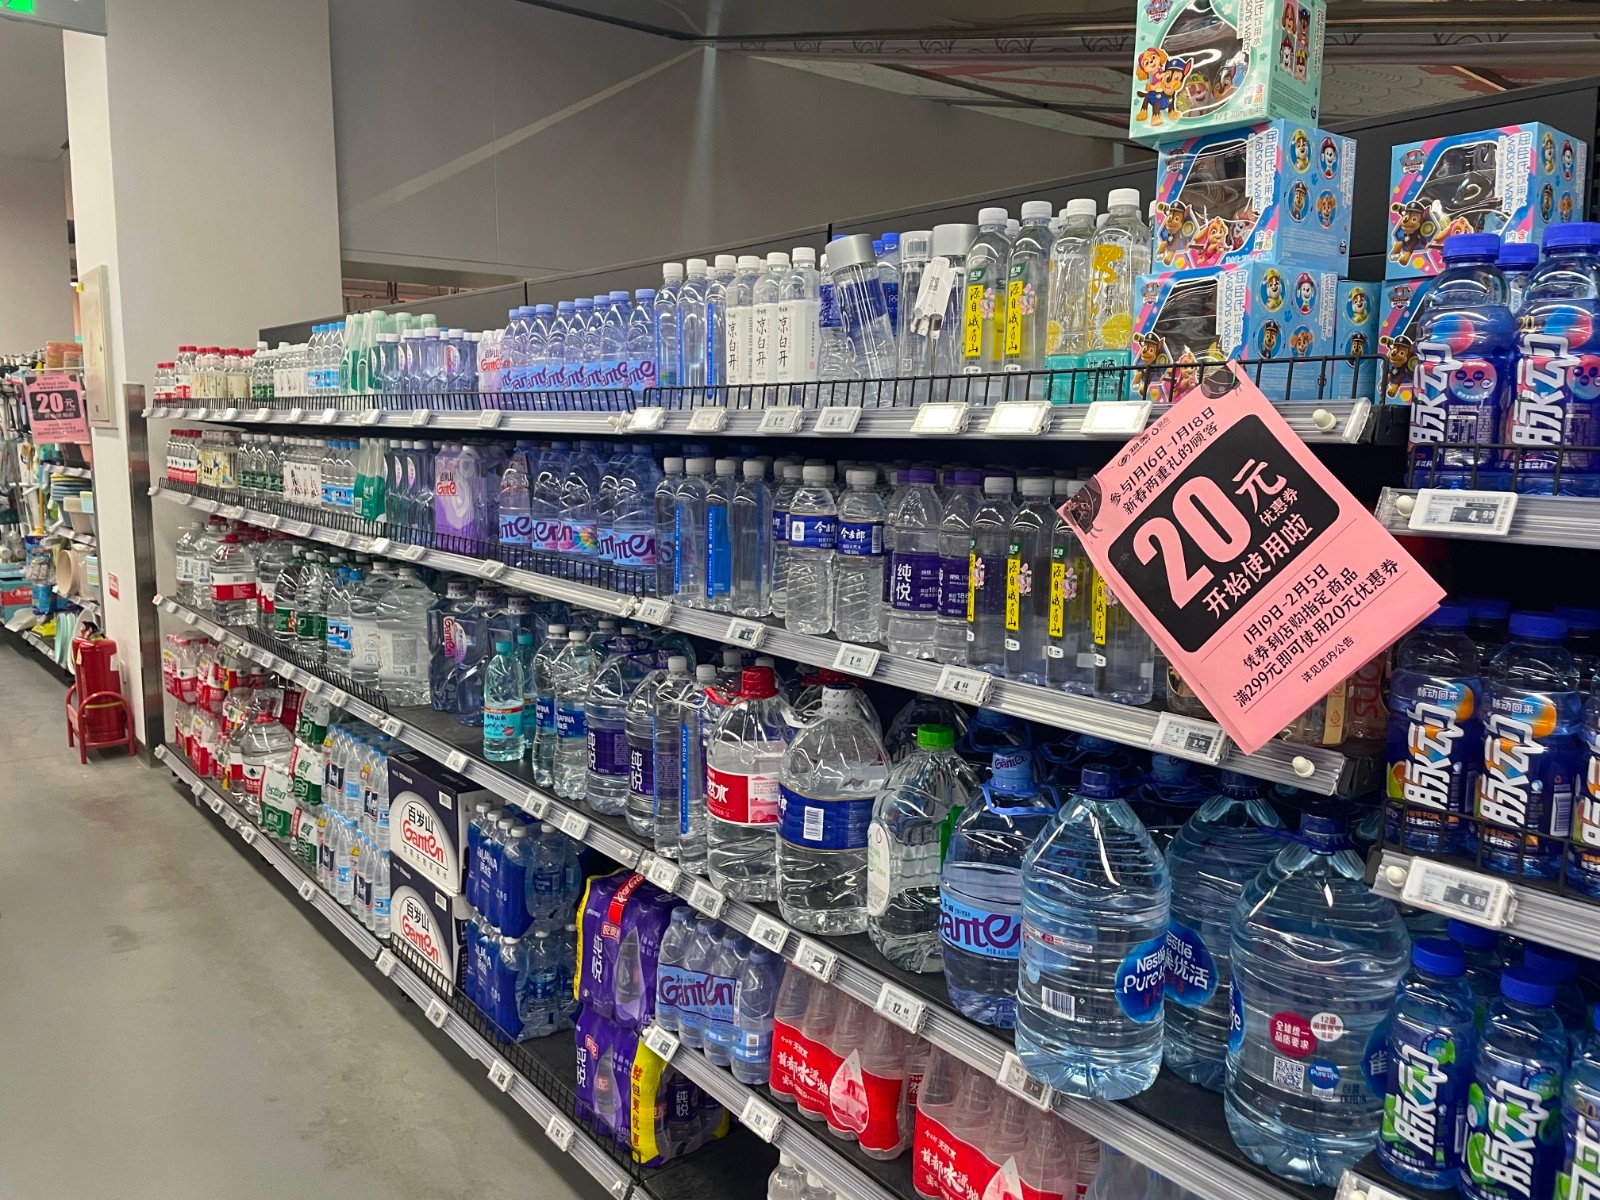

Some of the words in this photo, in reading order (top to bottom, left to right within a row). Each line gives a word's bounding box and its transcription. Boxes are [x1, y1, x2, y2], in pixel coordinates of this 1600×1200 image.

[1252, 0, 1265, 46] 氏饮用水
[1264, 131, 1277, 206] 屈臣氏饮用水
[1506, 136, 1515, 180] watsons
[1516, 133, 1530, 207] 屈臣氏饮用水
[1253, 181, 1262, 212] water
[1504, 182, 1513, 212] water
[1225, 271, 1233, 317] watsons
[1233, 271, 1246, 346] 屈臣氏饮用水
[756, 317, 767, 368] 凉白开
[778, 317, 789, 368] 凉白开
[1223, 320, 1231, 351] water
[36, 392, 64, 413] 20
[1122, 422, 1218, 515] 新春两重礼的顾客
[1258, 487, 1298, 527] 优惠券
[1467, 509, 1496, 523] 4.99
[841, 527, 866, 544] 今麦郎
[1133, 476, 1251, 610] 20
[1232, 458, 1287, 514] 元
[896, 563, 913, 602] 纯悦
[1202, 513, 1314, 620] 开始使用啦
[1243, 563, 1329, 645] 1月19日-2月5日
[1243, 567, 1358, 672] 凭券到店购指定商品
[444, 618, 456, 656] Ganten
[1233, 558, 1398, 708] 满299元即可使用20元优惠券
[1301, 635, 1355, 684] 详见店内公告
[1416, 686, 1459, 701] 脉动回来
[1491, 698, 1535, 715] 脉动回来
[631, 750, 643, 792] 纯悦
[408, 804, 435, 836] 百岁山
[402, 819, 445, 864] Ganten
[406, 901, 430, 933] 百岁山
[1460, 893, 1487, 907] 4.99
[402, 914, 439, 961] Ganten
[1165, 930, 1193, 959] estlé
[1123, 970, 1160, 994] Pure
[1163, 947, 1210, 991] 巢优活
[659, 974, 733, 1007] Ganten
[1274, 1033, 1309, 1050] 品质要求
[1275, 1019, 1310, 1037] 全球统一
[776, 1051, 830, 1097] 首都水源地
[676, 1090, 689, 1117] 纯悦
